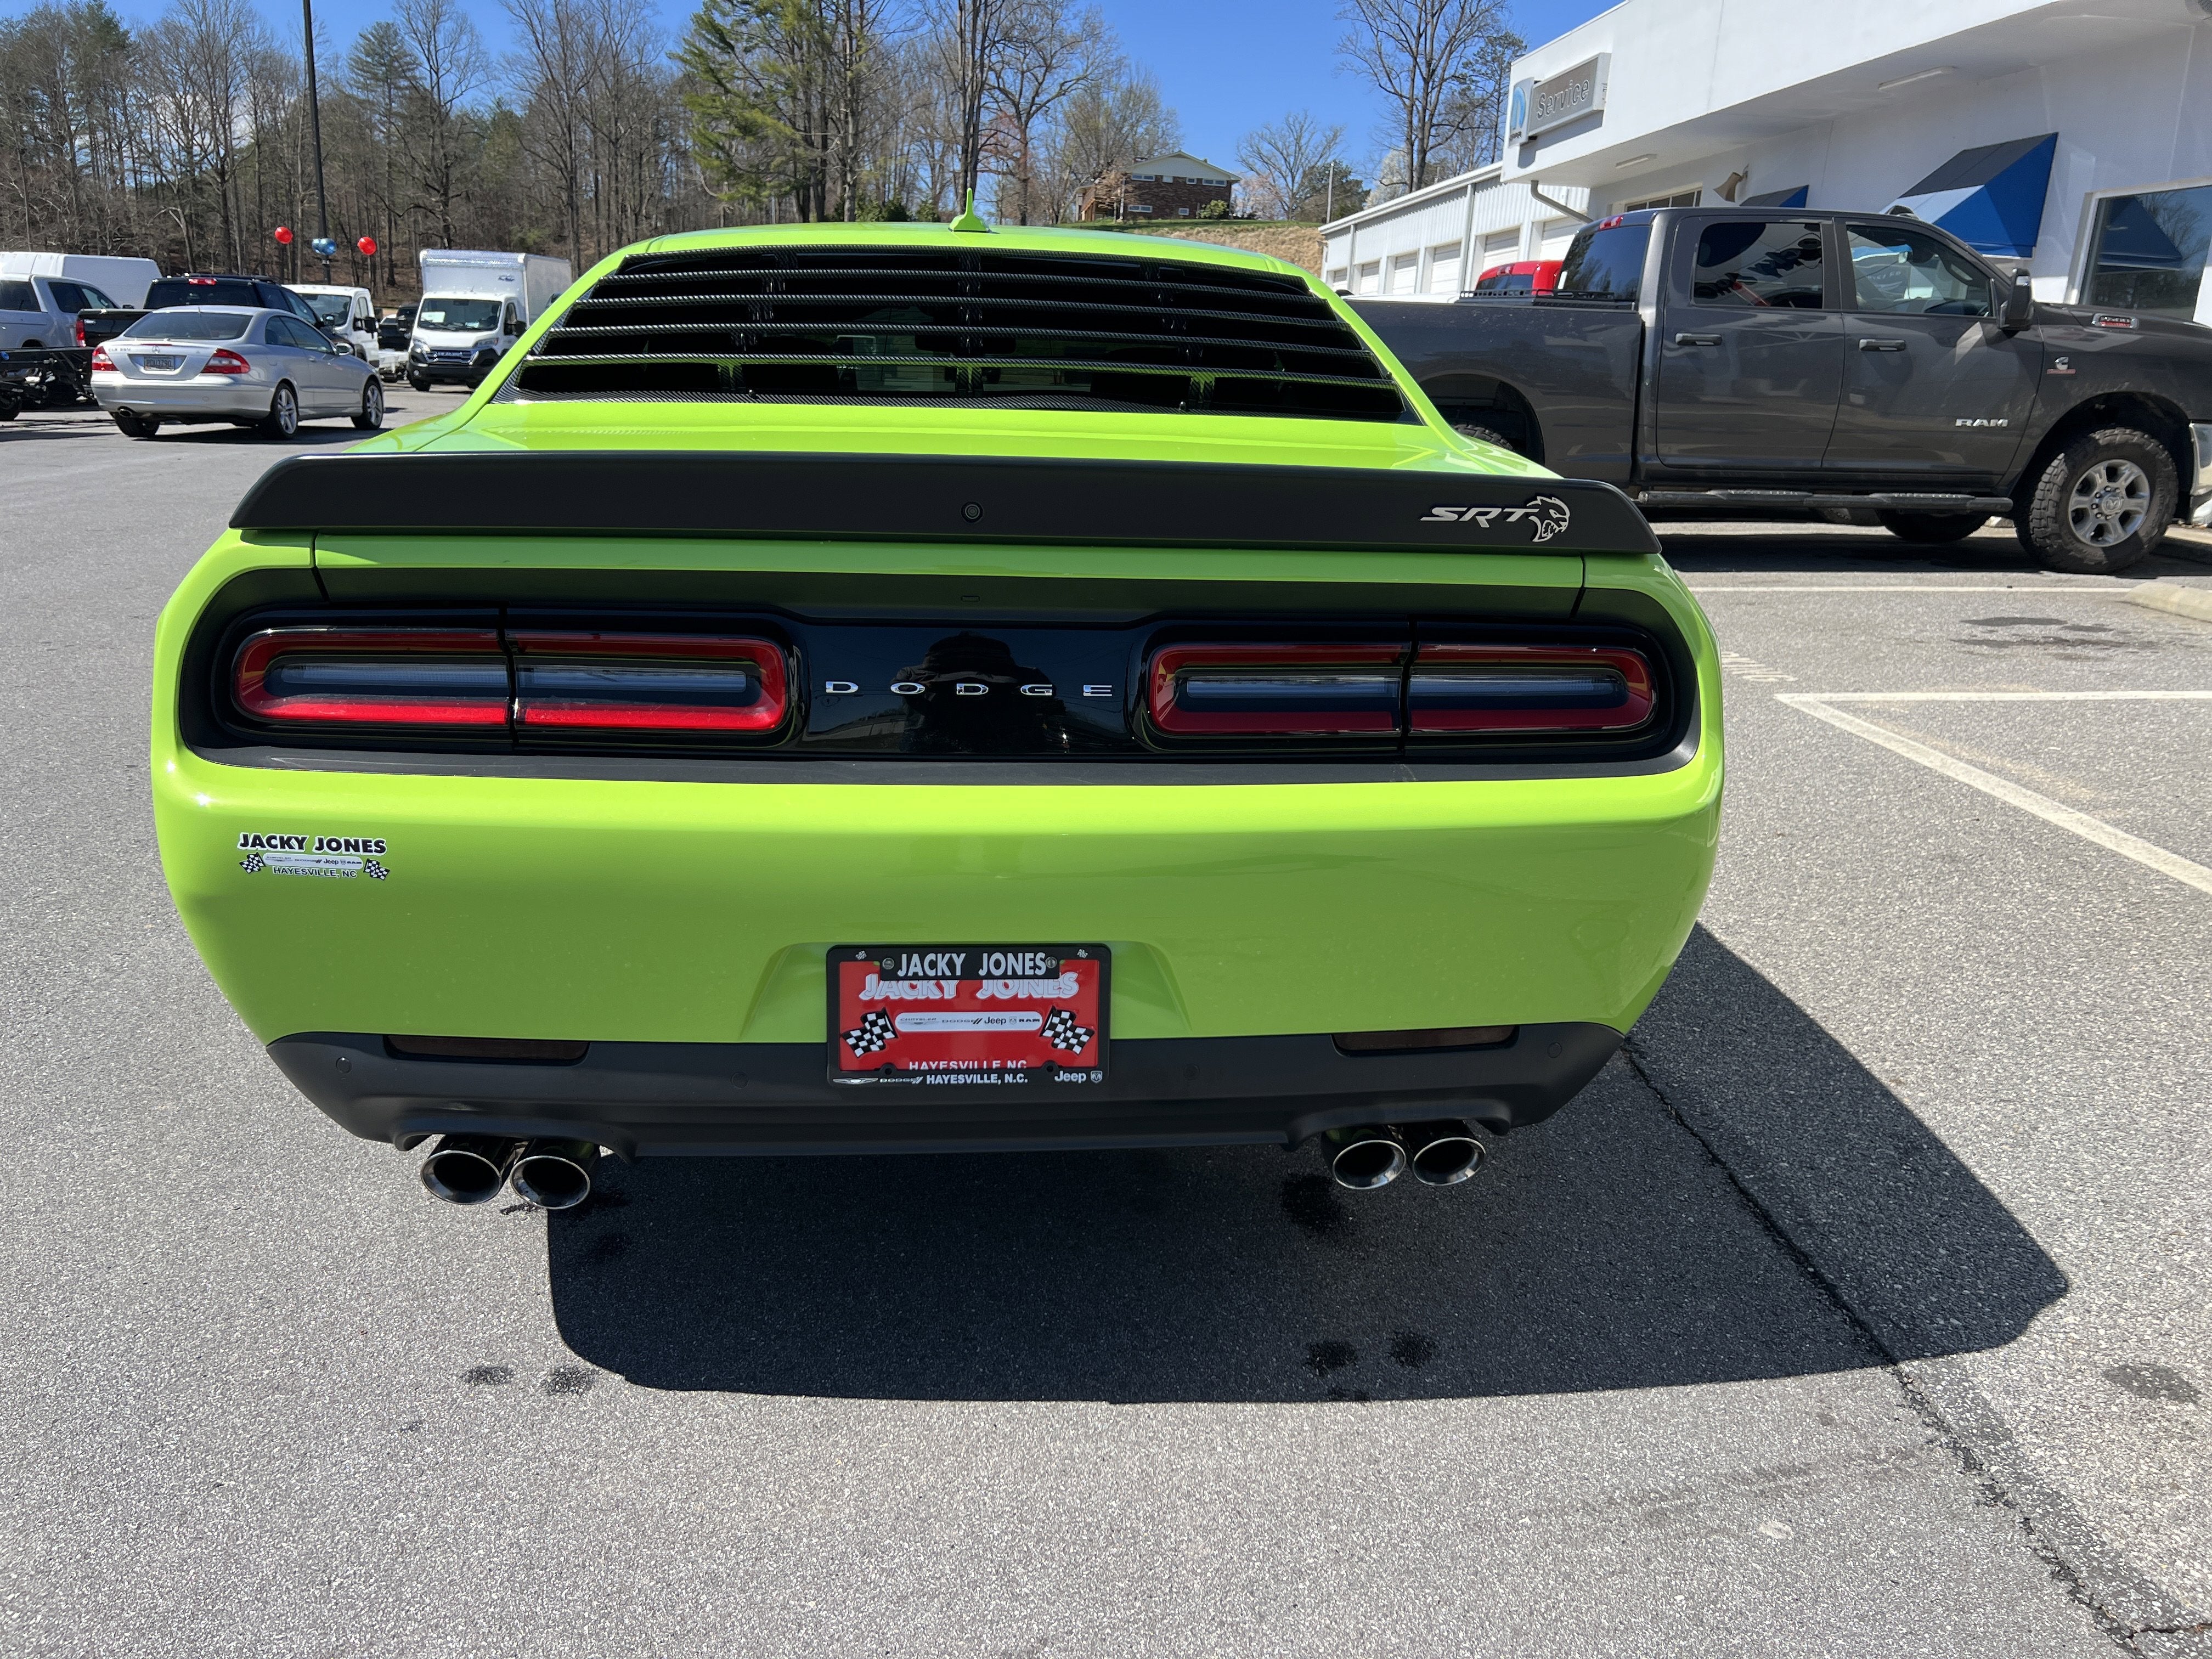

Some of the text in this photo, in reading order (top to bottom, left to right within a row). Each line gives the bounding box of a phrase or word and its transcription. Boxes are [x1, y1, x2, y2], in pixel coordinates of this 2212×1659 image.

[1537, 79, 1589, 120] Service
[1955, 419, 2008, 427] RAM
[1420, 507, 1539, 528] SRT
[826, 681, 1113, 697] DODGE
[238, 833, 387, 855] JACKY JONES
[274, 867, 340, 878] HAYESVILLE,
[898, 952, 1046, 976] JACKY JONES
[859, 972, 1079, 1000] JACKY JONES
[984, 1017, 1007, 1025] Jeep
[926, 1074, 1001, 1085] HAYESVILLE,
[1005, 1073, 1028, 1084] N.C.
[1054, 1071, 1087, 1083] Jeep
